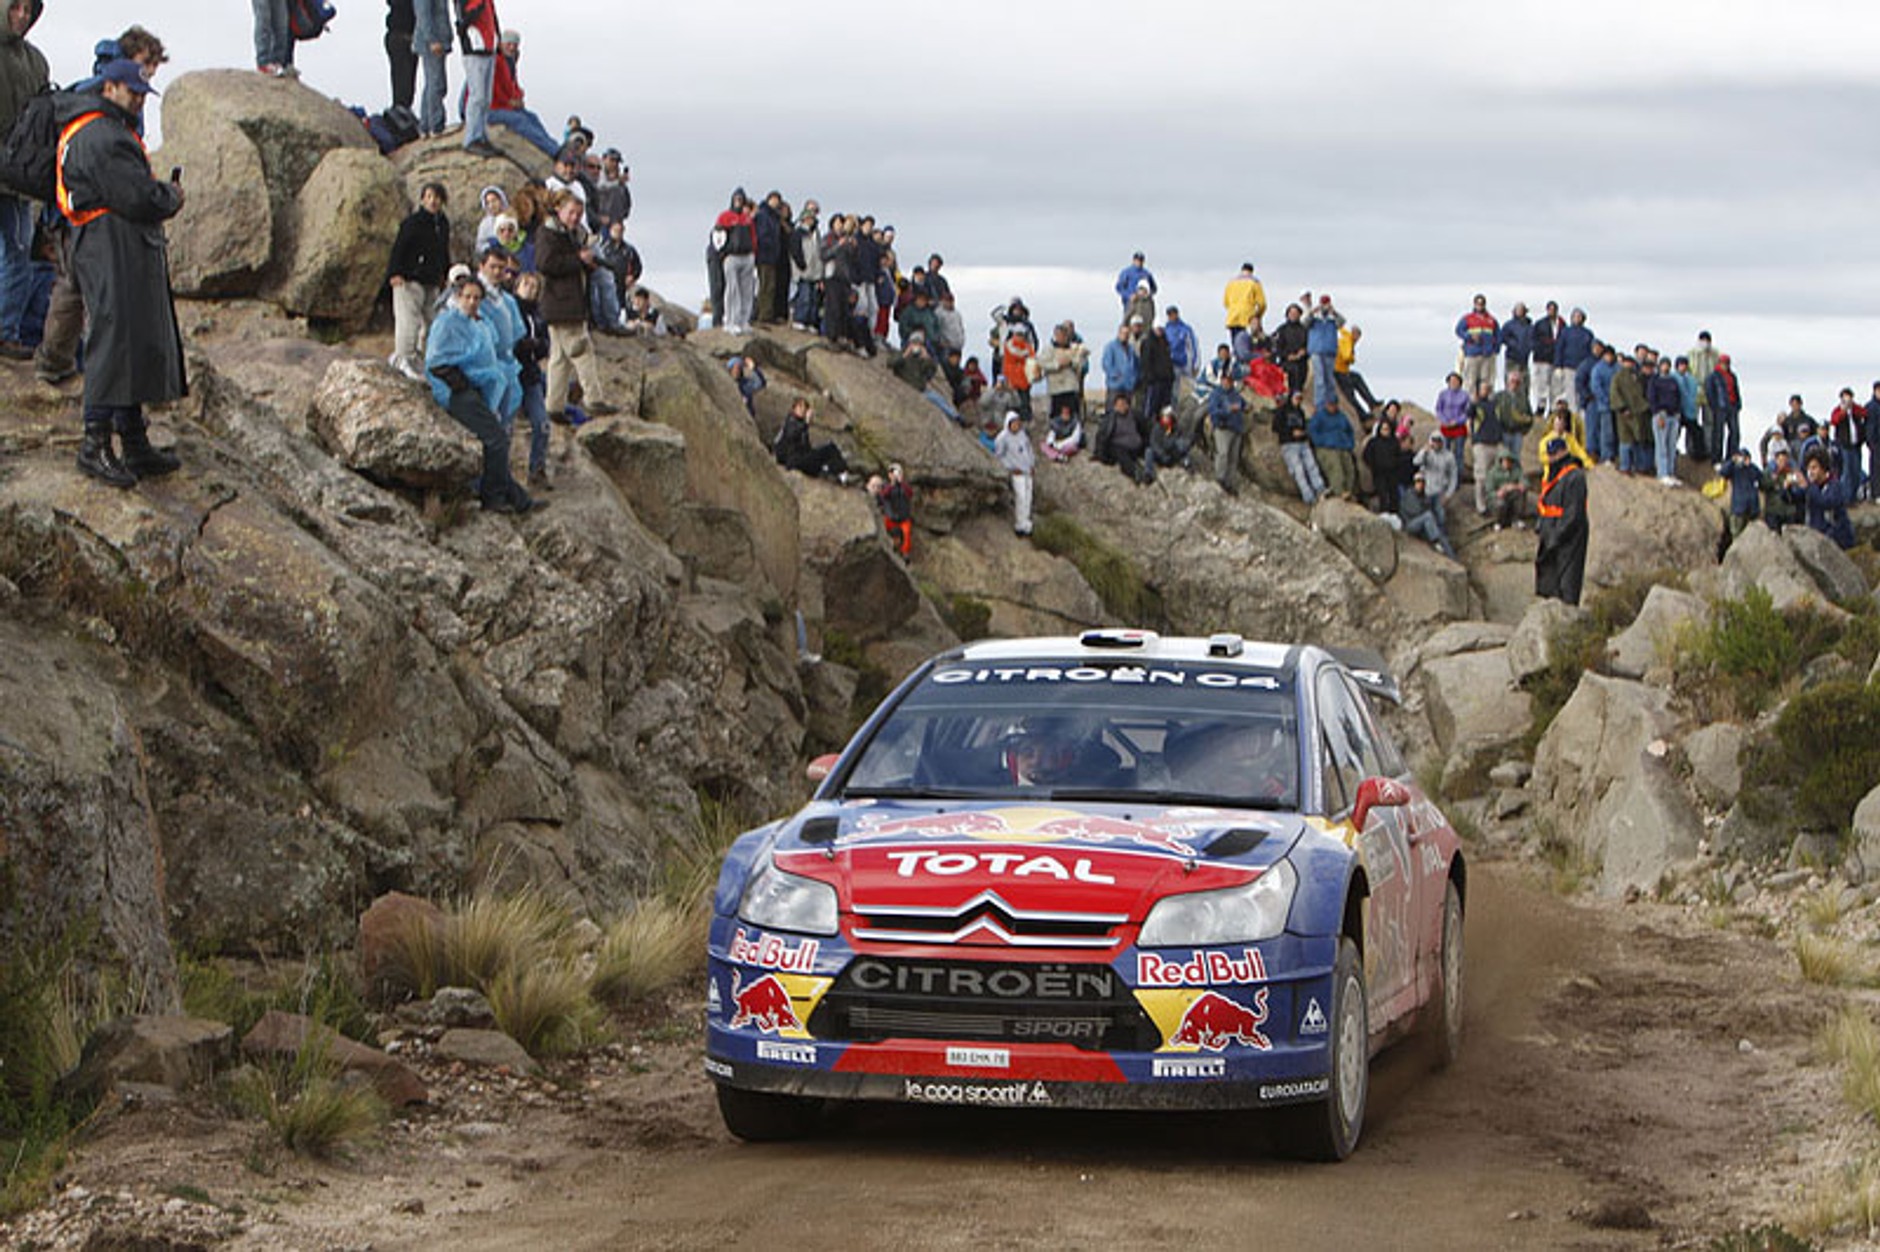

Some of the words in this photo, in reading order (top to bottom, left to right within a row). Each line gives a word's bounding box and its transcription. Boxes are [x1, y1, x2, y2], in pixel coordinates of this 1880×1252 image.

[932, 667, 1186, 686] CITROËN
[1196, 673, 1280, 690] C4
[886, 850, 1116, 884] TOTAL
[760, 933, 819, 973] Bull
[850, 961, 1113, 998] CITROËN
[1138, 951, 1206, 986] Red
[1207, 948, 1268, 985] Bull
[1012, 1018, 1111, 1038] SPORT
[757, 1040, 816, 1063] PIRELLI
[1153, 1058, 1225, 1077] PIRELLI
[905, 1078, 922, 1098] le
[924, 1084, 962, 1103] coq
[966, 1082, 1027, 1103] sportif
